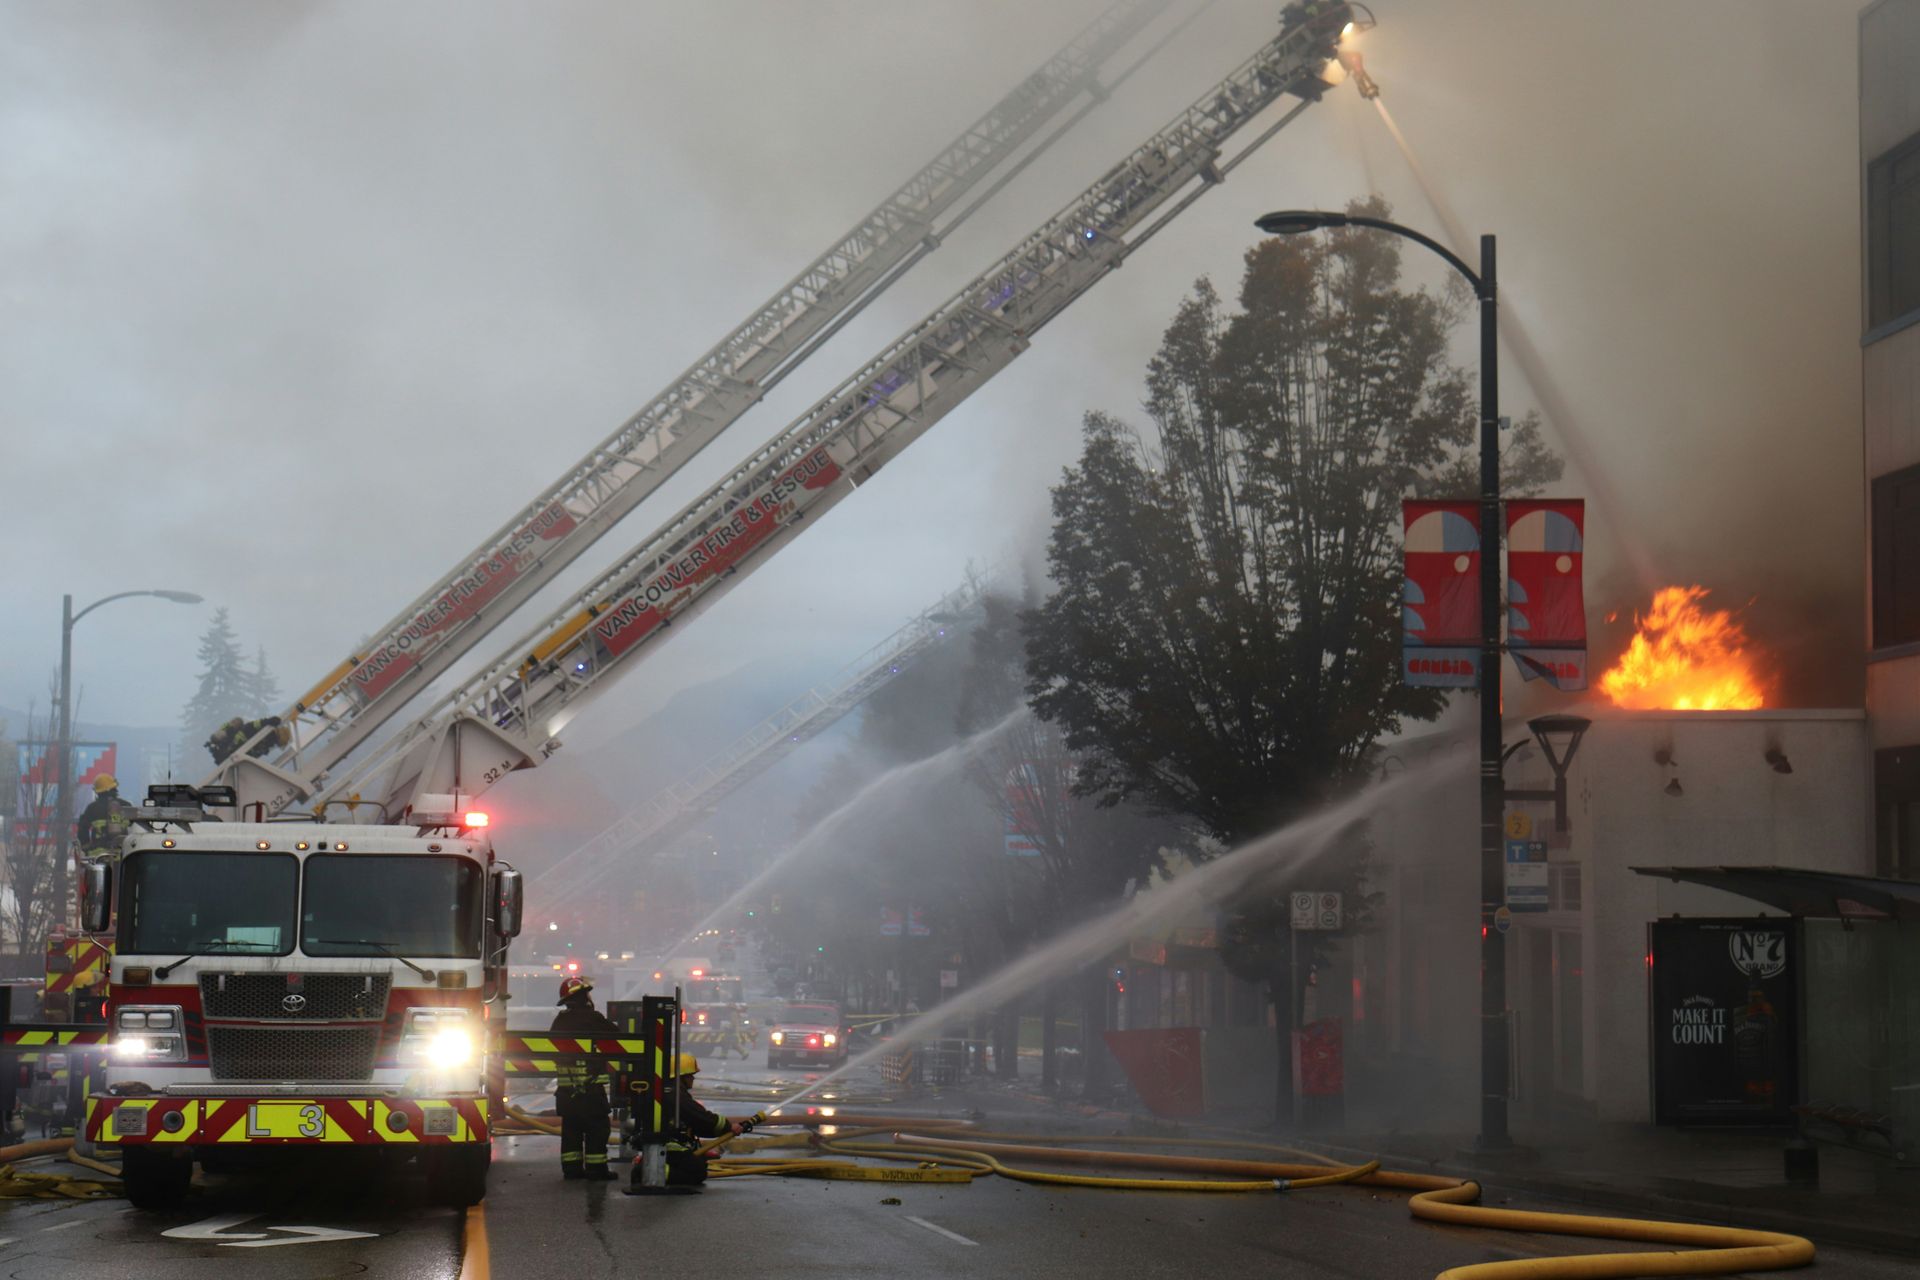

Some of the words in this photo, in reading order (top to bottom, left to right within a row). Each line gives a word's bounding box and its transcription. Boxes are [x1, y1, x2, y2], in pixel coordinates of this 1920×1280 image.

[1136, 162, 1152, 178] L
[1151, 149, 1167, 168] 3
[598, 549, 707, 639] VANCOUVER
[705, 518, 747, 555] FIRE
[746, 505, 763, 523] &
[762, 451, 830, 510] RESCUE
[356, 600, 453, 684] VANCOUVER
[450, 570, 490, 604] FIRE
[487, 557, 502, 573] &
[502, 504, 566, 562] RESCUE
[483, 768, 500, 784] 32
[501, 760, 512, 770] M
[270, 795, 286, 809] 32
[1512, 822, 1523, 834] 2
[1511, 845, 1523, 860] T
[1672, 1008, 1708, 1024] MAKE
[1712, 1008, 1726, 1024] IT
[1672, 1024, 1726, 1044] COUNT
[248, 1104, 271, 1136] L
[298, 1104, 324, 1137] 3
